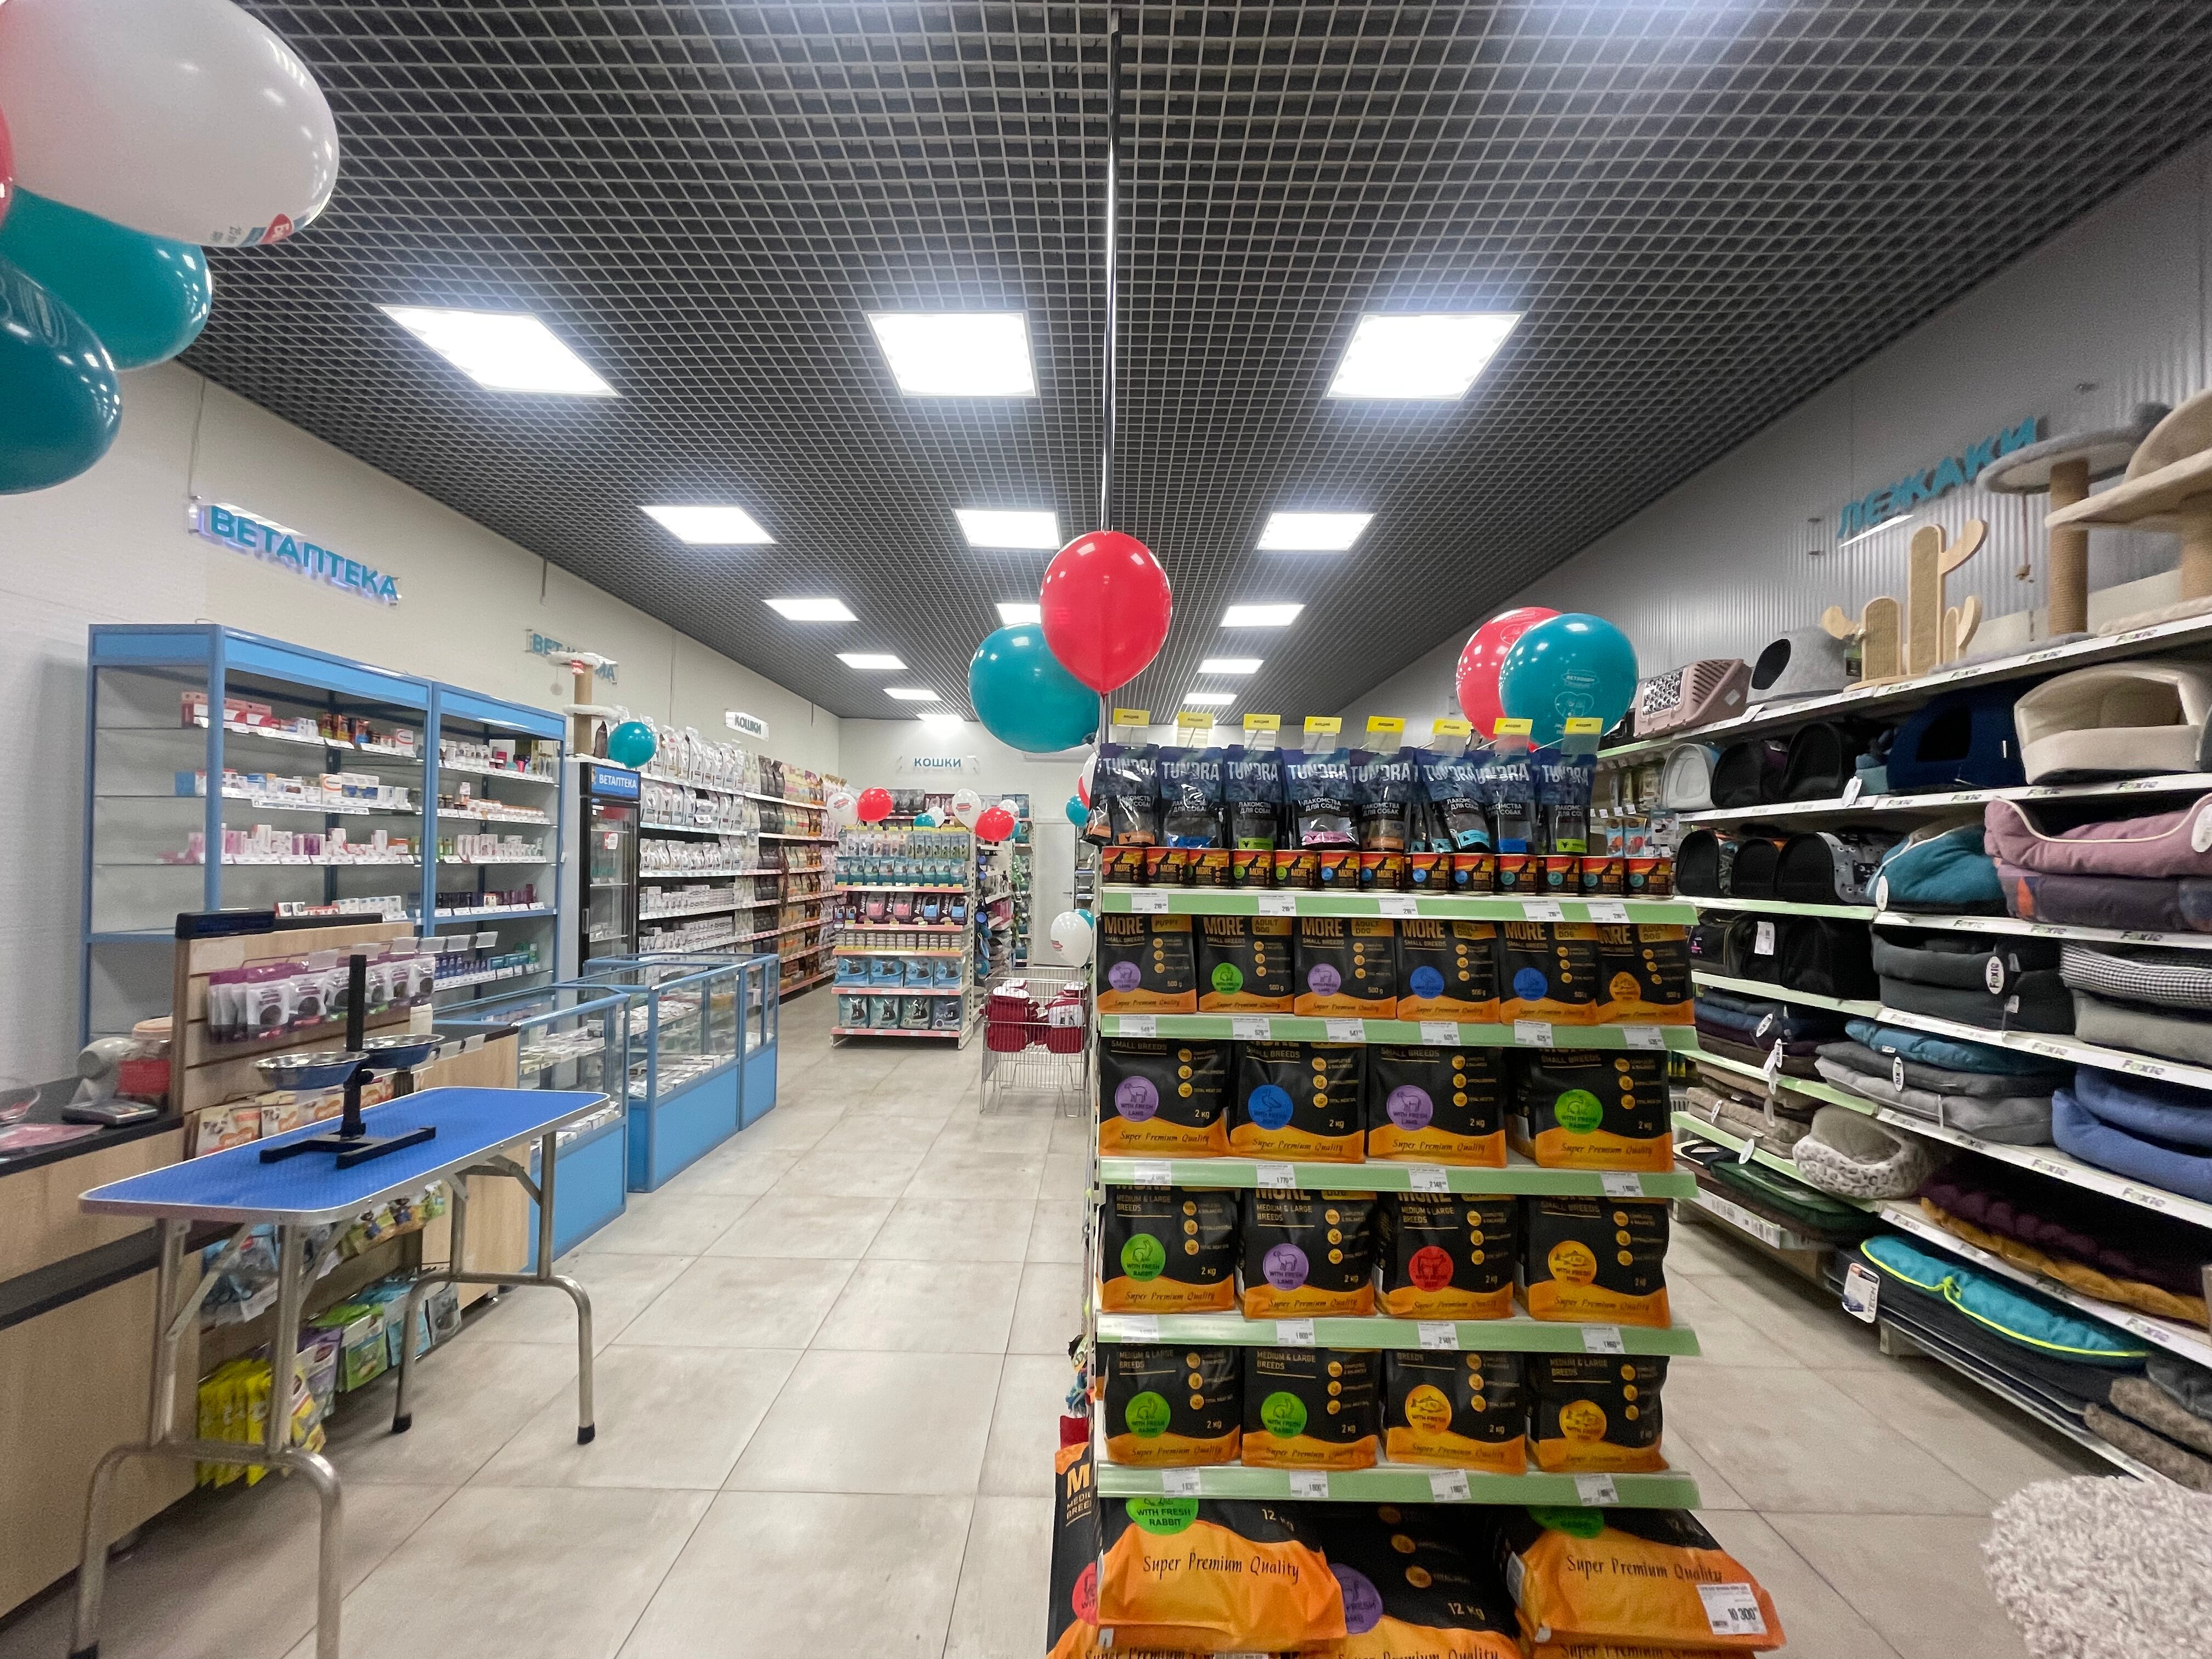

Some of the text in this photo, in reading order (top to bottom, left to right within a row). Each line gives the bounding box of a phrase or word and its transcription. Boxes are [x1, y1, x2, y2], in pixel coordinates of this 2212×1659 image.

[1837, 416, 2036, 539] ЛЕЖАКИ
[211, 505, 398, 601] ВЕТАПТЕКА
[735, 714, 761, 735] КОШКИ
[914, 757, 962, 768] КОШКИ
[1103, 758, 1158, 778] TUNDRA
[1161, 761, 1220, 781] TUNDRA
[1228, 761, 1279, 781] TUNDRA
[1288, 763, 1348, 781] TUNDRA
[1351, 763, 1410, 782] TUNDRA
[1424, 763, 1477, 783] TUNDRA
[1542, 764, 1589, 786] TUNDRA
[599, 774, 637, 789] ВЕТАПТЕКА
[1303, 798, 1341, 806] ЛАКОМСТВА
[1322, 804, 1340, 812] СОБАК
[1378, 808, 1400, 816] СОБАК
[1114, 864, 1130, 873] MORE
[1160, 864, 1176, 873] MORE
[1197, 866, 1212, 875] MORE
[1249, 867, 1265, 876] MORE
[1291, 867, 1307, 877] MORE
[1339, 868, 1355, 877] MORE
[1377, 870, 1393, 878] MORE
[1104, 916, 1144, 935] MORE
[1155, 919, 1178, 927] PUPPY
[1204, 916, 1244, 936] MORE
[1302, 917, 1343, 937] MORE
[1402, 920, 1443, 939] MORE
[1505, 922, 1547, 940] MORE
[2120, 930, 2163, 942] Foxie
[1989, 962, 2000, 989] Foxie
[1115, 999, 1131, 1008] Super
[1160, 998, 1180, 1007] Quality
[1216, 1001, 1233, 1011] Super
[1260, 1002, 1281, 1011] Quality
[1314, 1003, 1330, 1012] Super
[1359, 1003, 1380, 1013] Quality
[1416, 1006, 1432, 1015] Super
[1463, 1006, 1483, 1015] Quality
[1138, 1042, 1167, 1051] BREEDS
[2032, 1042, 2068, 1057] Foxie
[1381, 1048, 1440, 1058] SMALL BREEDS
[2121, 1060, 2166, 1076] Foxie
[1195, 1109, 1200, 1118] 2
[1329, 1119, 1334, 1127] 2
[1120, 1131, 1210, 1144] Super Premium Quality
[1252, 1138, 1344, 1153] Super Premium Quality
[1392, 1139, 1485, 1154] Super Premium Quality
[1561, 1142, 1653, 1156] Super Premium Quality
[2031, 1159, 2068, 1177] Foxie
[1116, 1194, 1142, 1203] MEDIUM
[2121, 1187, 2166, 1209] Foxie
[1116, 1204, 1142, 1212] BREEDS
[1257, 1204, 1282, 1212] MEDIUM
[1290, 1205, 1312, 1213] LARGE
[1431, 1207, 1454, 1215] LARGE
[1257, 1212, 1283, 1221] BREEDS
[1403, 1215, 1427, 1223] BREEDS
[1201, 1267, 1206, 1275] 2
[1126, 1291, 1215, 1302] Super Premium Quality
[1867, 1286, 1876, 1313] TECH
[1268, 1297, 1357, 1309] Super Premium Quality
[1414, 1301, 1434, 1311] Super
[1555, 1296, 1578, 1307] Super
[1582, 1299, 1616, 1310] Premium
[2126, 1317, 2170, 1343] Foxie
[1256, 1351, 1284, 1361] MEDIUM
[1293, 1354, 1316, 1363] LARGE
[1397, 1352, 1424, 1362] BREEDS
[1119, 1361, 1145, 1369] BREEDS
[1257, 1361, 1285, 1370] BREEDS
[1131, 1445, 1223, 1457] Super Premium Quality
[1266, 1448, 1288, 1458] Super
[1291, 1449, 1325, 1459] Premium
[1412, 1442, 1505, 1460] Super Premium Quality
[1137, 1508, 1191, 1517] WITH FRESH
[1262, 1509, 1276, 1521] 12
[1149, 1517, 1182, 1527] RABBIT
[1142, 1552, 1300, 1584] Super Premium Quality
[1566, 1556, 1723, 1583] Super Premium Quality
[1448, 1602, 1465, 1616] 12
